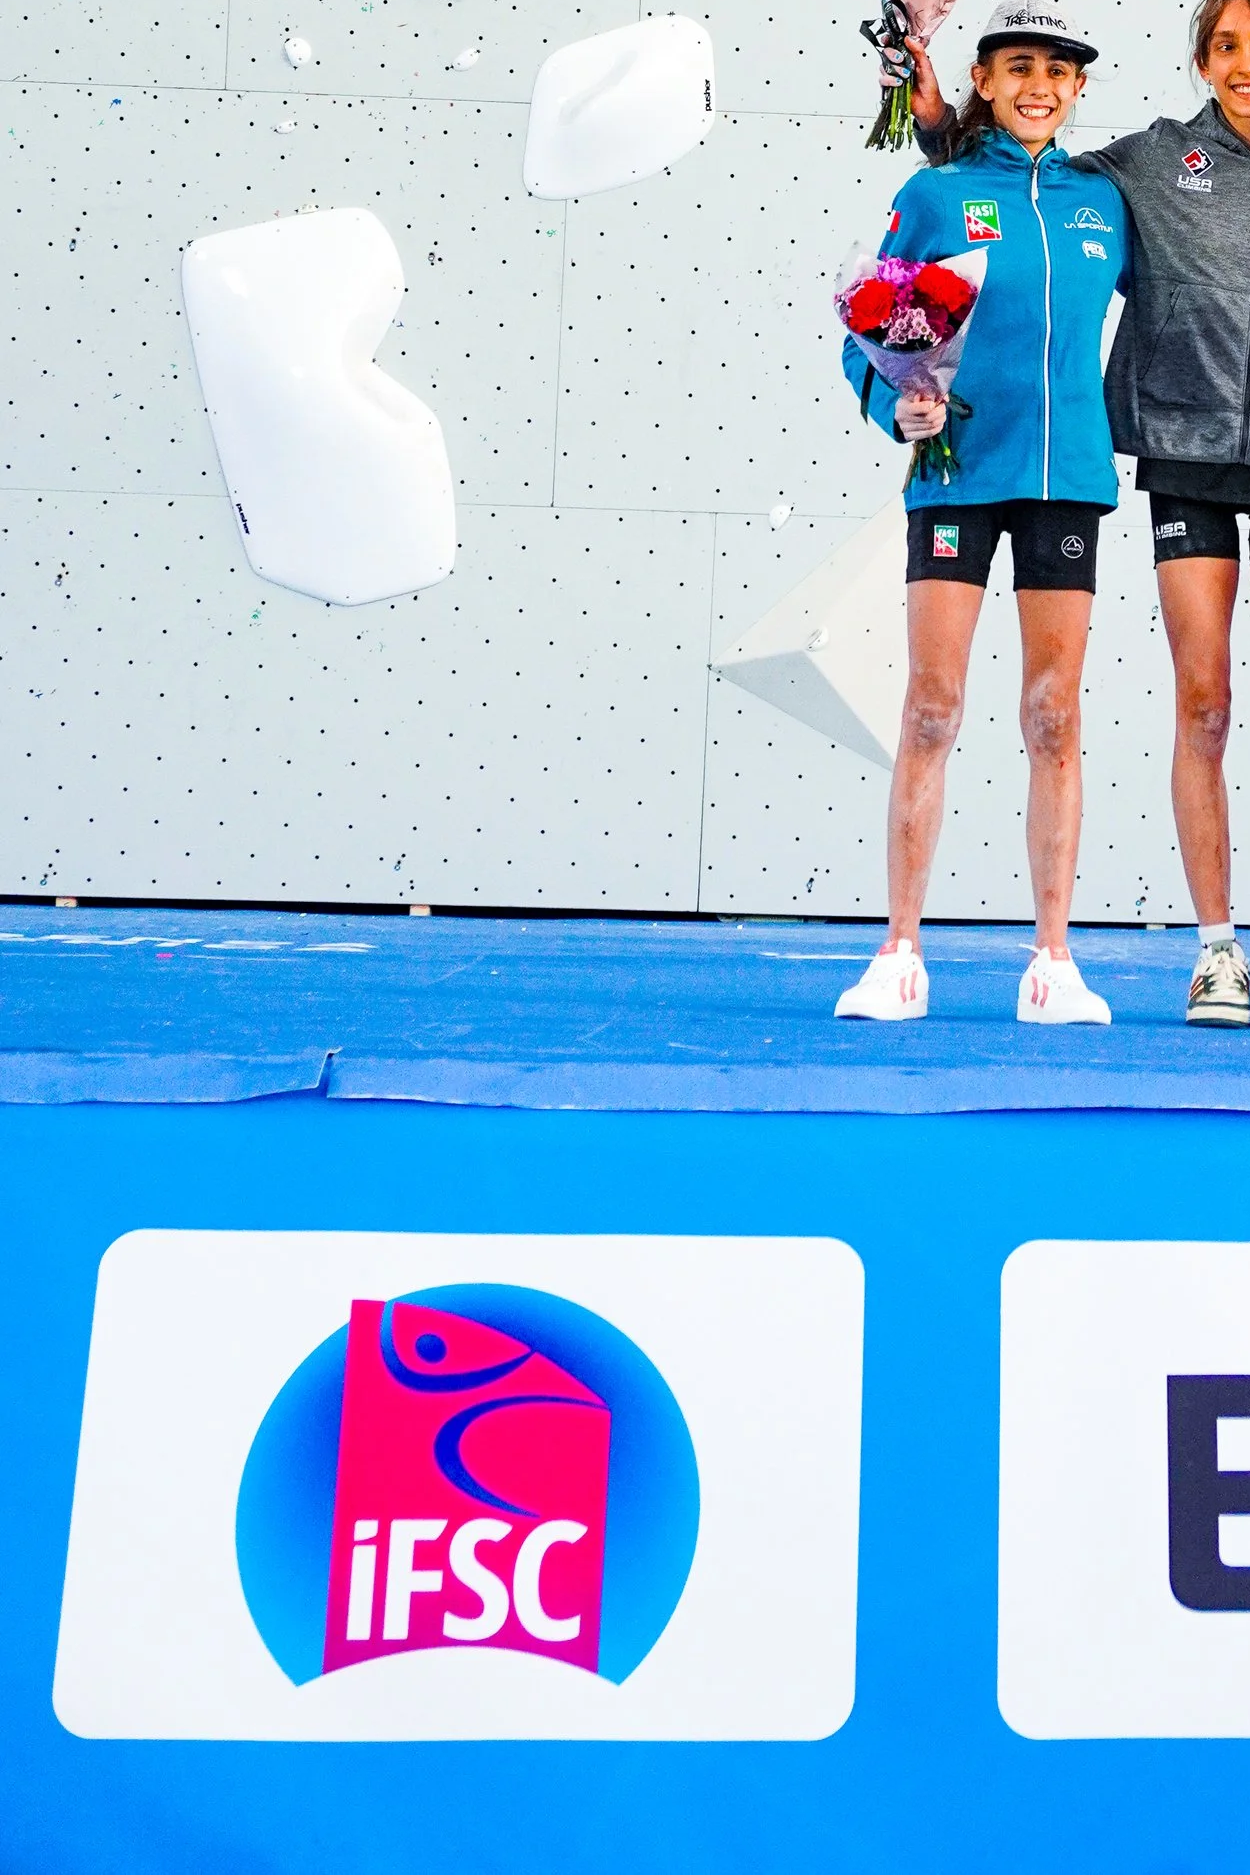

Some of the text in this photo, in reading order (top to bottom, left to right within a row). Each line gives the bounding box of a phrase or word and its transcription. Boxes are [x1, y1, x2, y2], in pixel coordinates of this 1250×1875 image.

[1004, 14, 1067, 31] TRENTINO
[704, 79, 712, 111] pusher
[1178, 175, 1212, 189] USA
[969, 205, 994, 217] FASI
[938, 529, 956, 538] FASI
[1156, 521, 1187, 535] USA
[347, 1519, 587, 1641] iFSC
